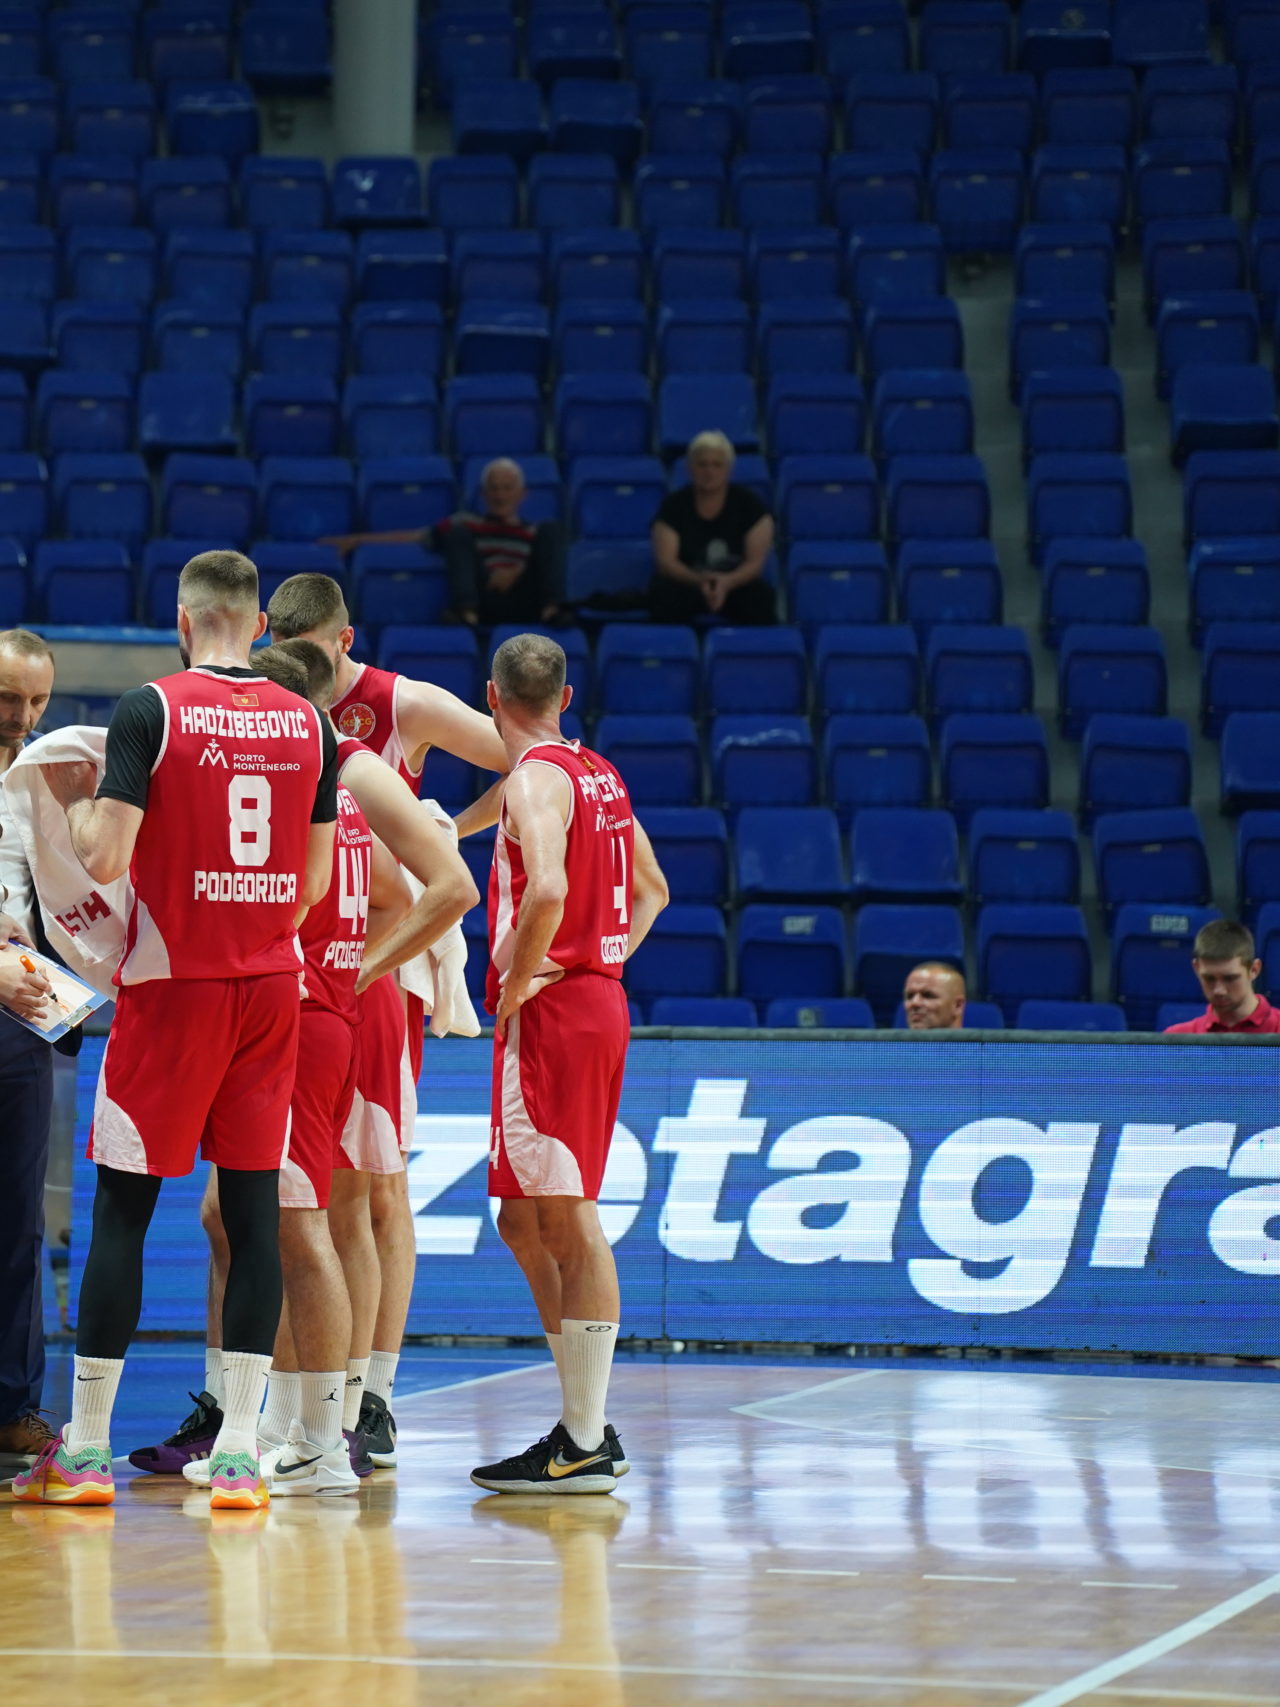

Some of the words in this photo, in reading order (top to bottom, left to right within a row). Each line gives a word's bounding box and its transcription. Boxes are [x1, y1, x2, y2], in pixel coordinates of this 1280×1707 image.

[180, 704, 309, 739] HADŽIBEGOVIĆ
[233, 753, 266, 762] PORTO
[233, 762, 301, 771] MONTENEGRO
[228, 774, 272, 867] 8
[194, 870, 297, 903] PODGORICA
[338, 846, 371, 935] 44
